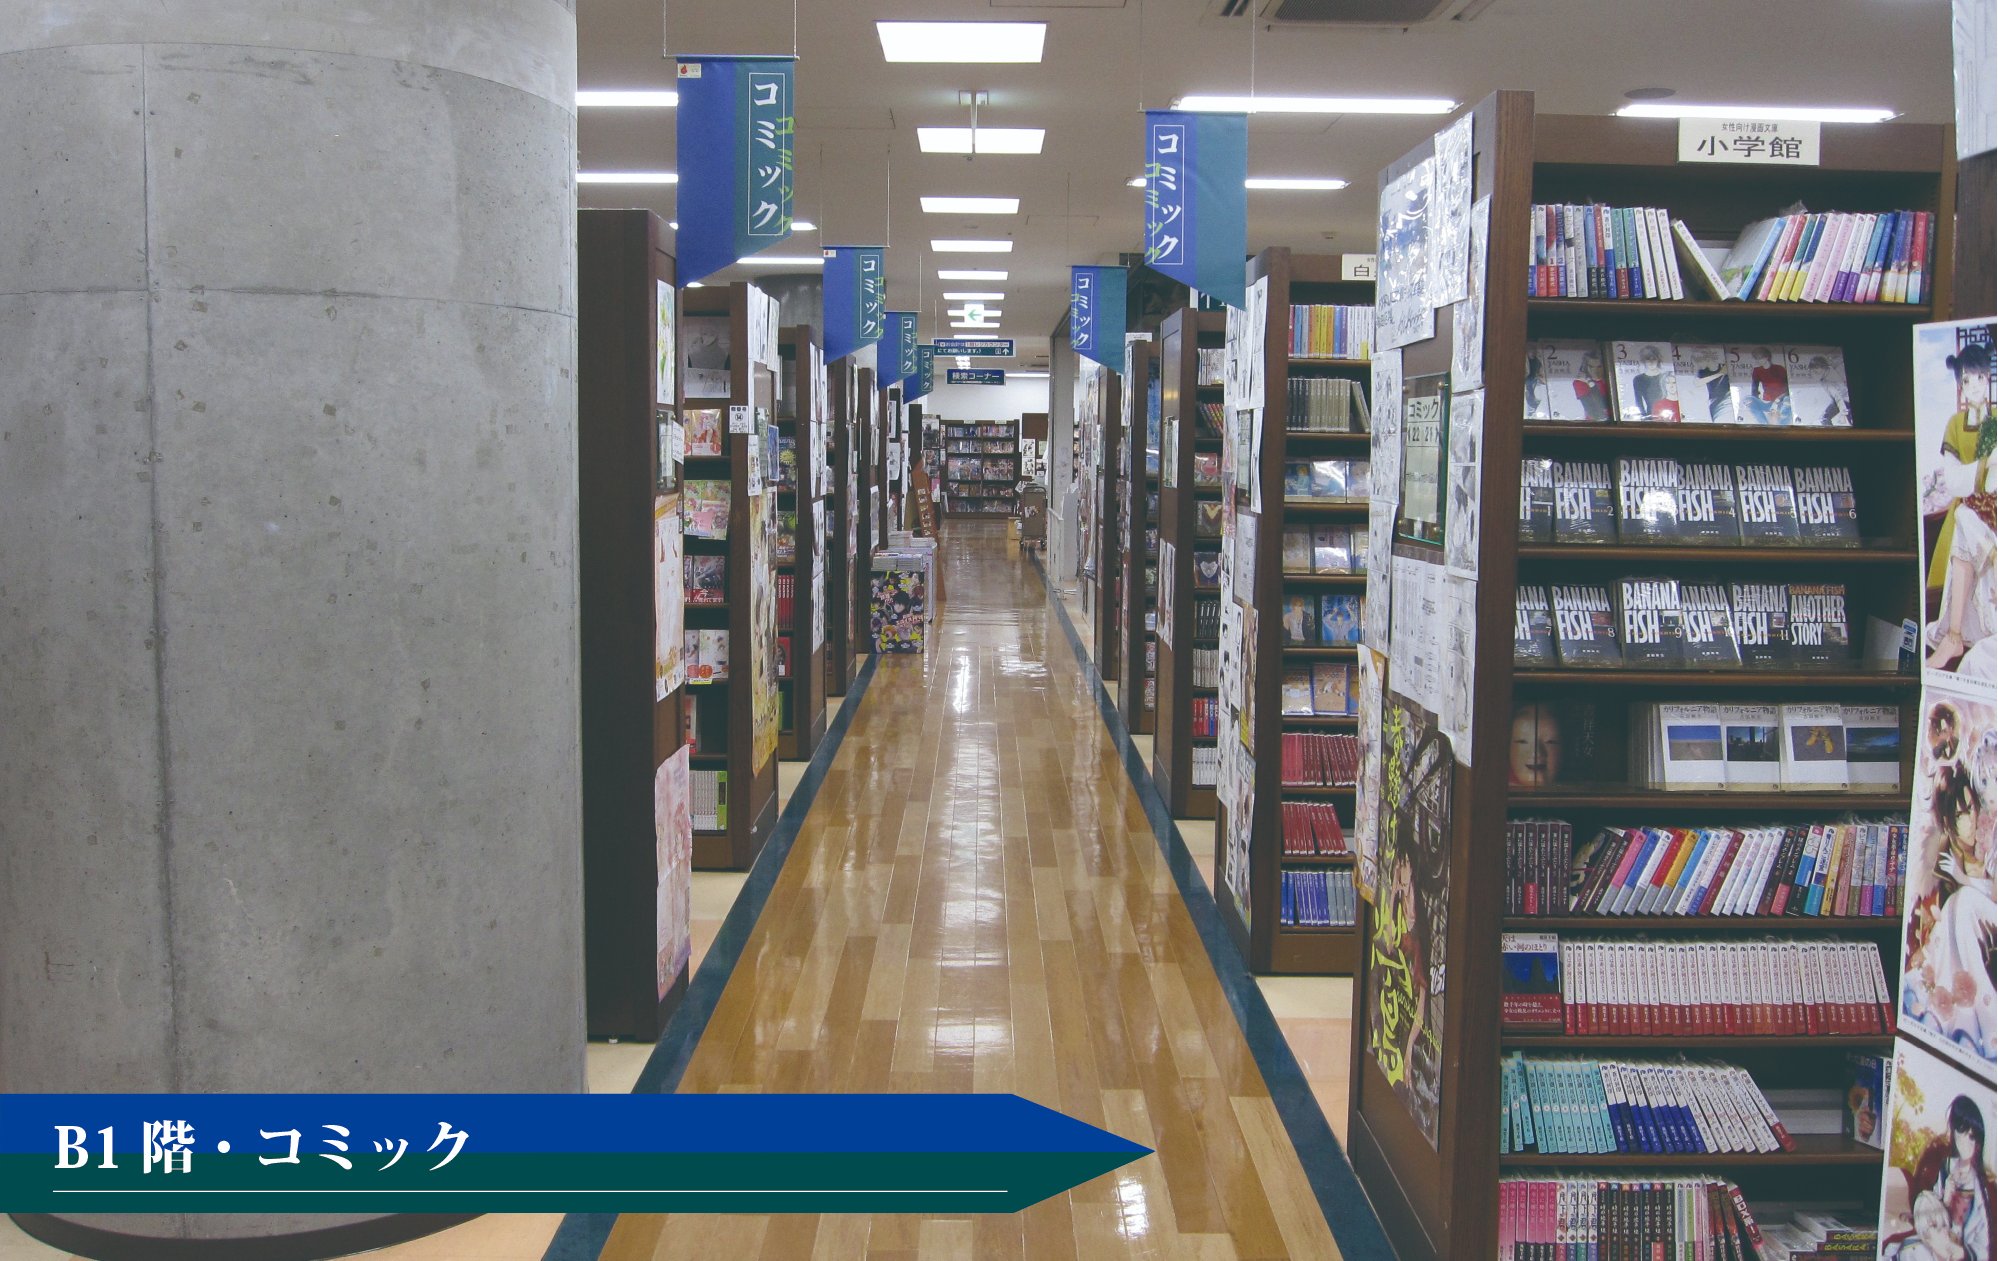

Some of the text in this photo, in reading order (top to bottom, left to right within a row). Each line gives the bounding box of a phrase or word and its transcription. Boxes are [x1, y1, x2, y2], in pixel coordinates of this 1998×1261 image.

[753, 83, 781, 229] コミック
[1696, 135, 1802, 158] 小学館
[1157, 133, 1182, 259] コミック
[1354, 264, 1376, 277] 白
[862, 260, 878, 335] コミック
[1077, 277, 1091, 346] コミック
[904, 320, 914, 371] コミック
[1546, 345, 1557, 360] 2
[1617, 344, 1627, 359] 3
[1672, 345, 1681, 360] 4
[1730, 347, 1740, 363] 5
[1788, 348, 1799, 364] 6
[923, 351, 931, 389] コミック
[952, 372, 1000, 380] 検索コーナー
[1408, 399, 1438, 419] コミック
[1554, 462, 1612, 489] BANANA
[1620, 459, 1677, 487] BANANA
[1677, 464, 1733, 489] BANANA
[1736, 465, 1793, 490] BANANA
[1794, 467, 1853, 492] BANANA
[1555, 487, 1592, 520] FISH
[1607, 506, 1614, 516] 2
[1679, 490, 1715, 521] FISH
[1728, 507, 1736, 517] 4
[1739, 491, 1777, 522] FISH
[1797, 492, 1835, 523] FISH
[1849, 509, 1856, 519] 6
[1552, 585, 1610, 611] BANANA
[1623, 581, 1681, 610] BANANA
[1682, 586, 1727, 611] ANANA
[1732, 585, 1788, 612] BANANA
[1789, 585, 1844, 595] BANANA FISH
[1791, 595, 1846, 622] ANOTHER
[1555, 610, 1595, 641] FISH
[1607, 627, 1615, 638] 8
[1624, 610, 1660, 643] FISH
[1675, 627, 1682, 638] 9
[1682, 611, 1714, 643] ISH
[1734, 612, 1768, 645] FISH
[1791, 623, 1823, 645] STORY
[1663, 705, 1717, 714] カリフォルニア物語
[1723, 706, 1778, 714] カリフォルニア物語
[1786, 705, 1839, 714] カリフォルニア物語
[1843, 707, 1897, 715] カリフォルニア物語
